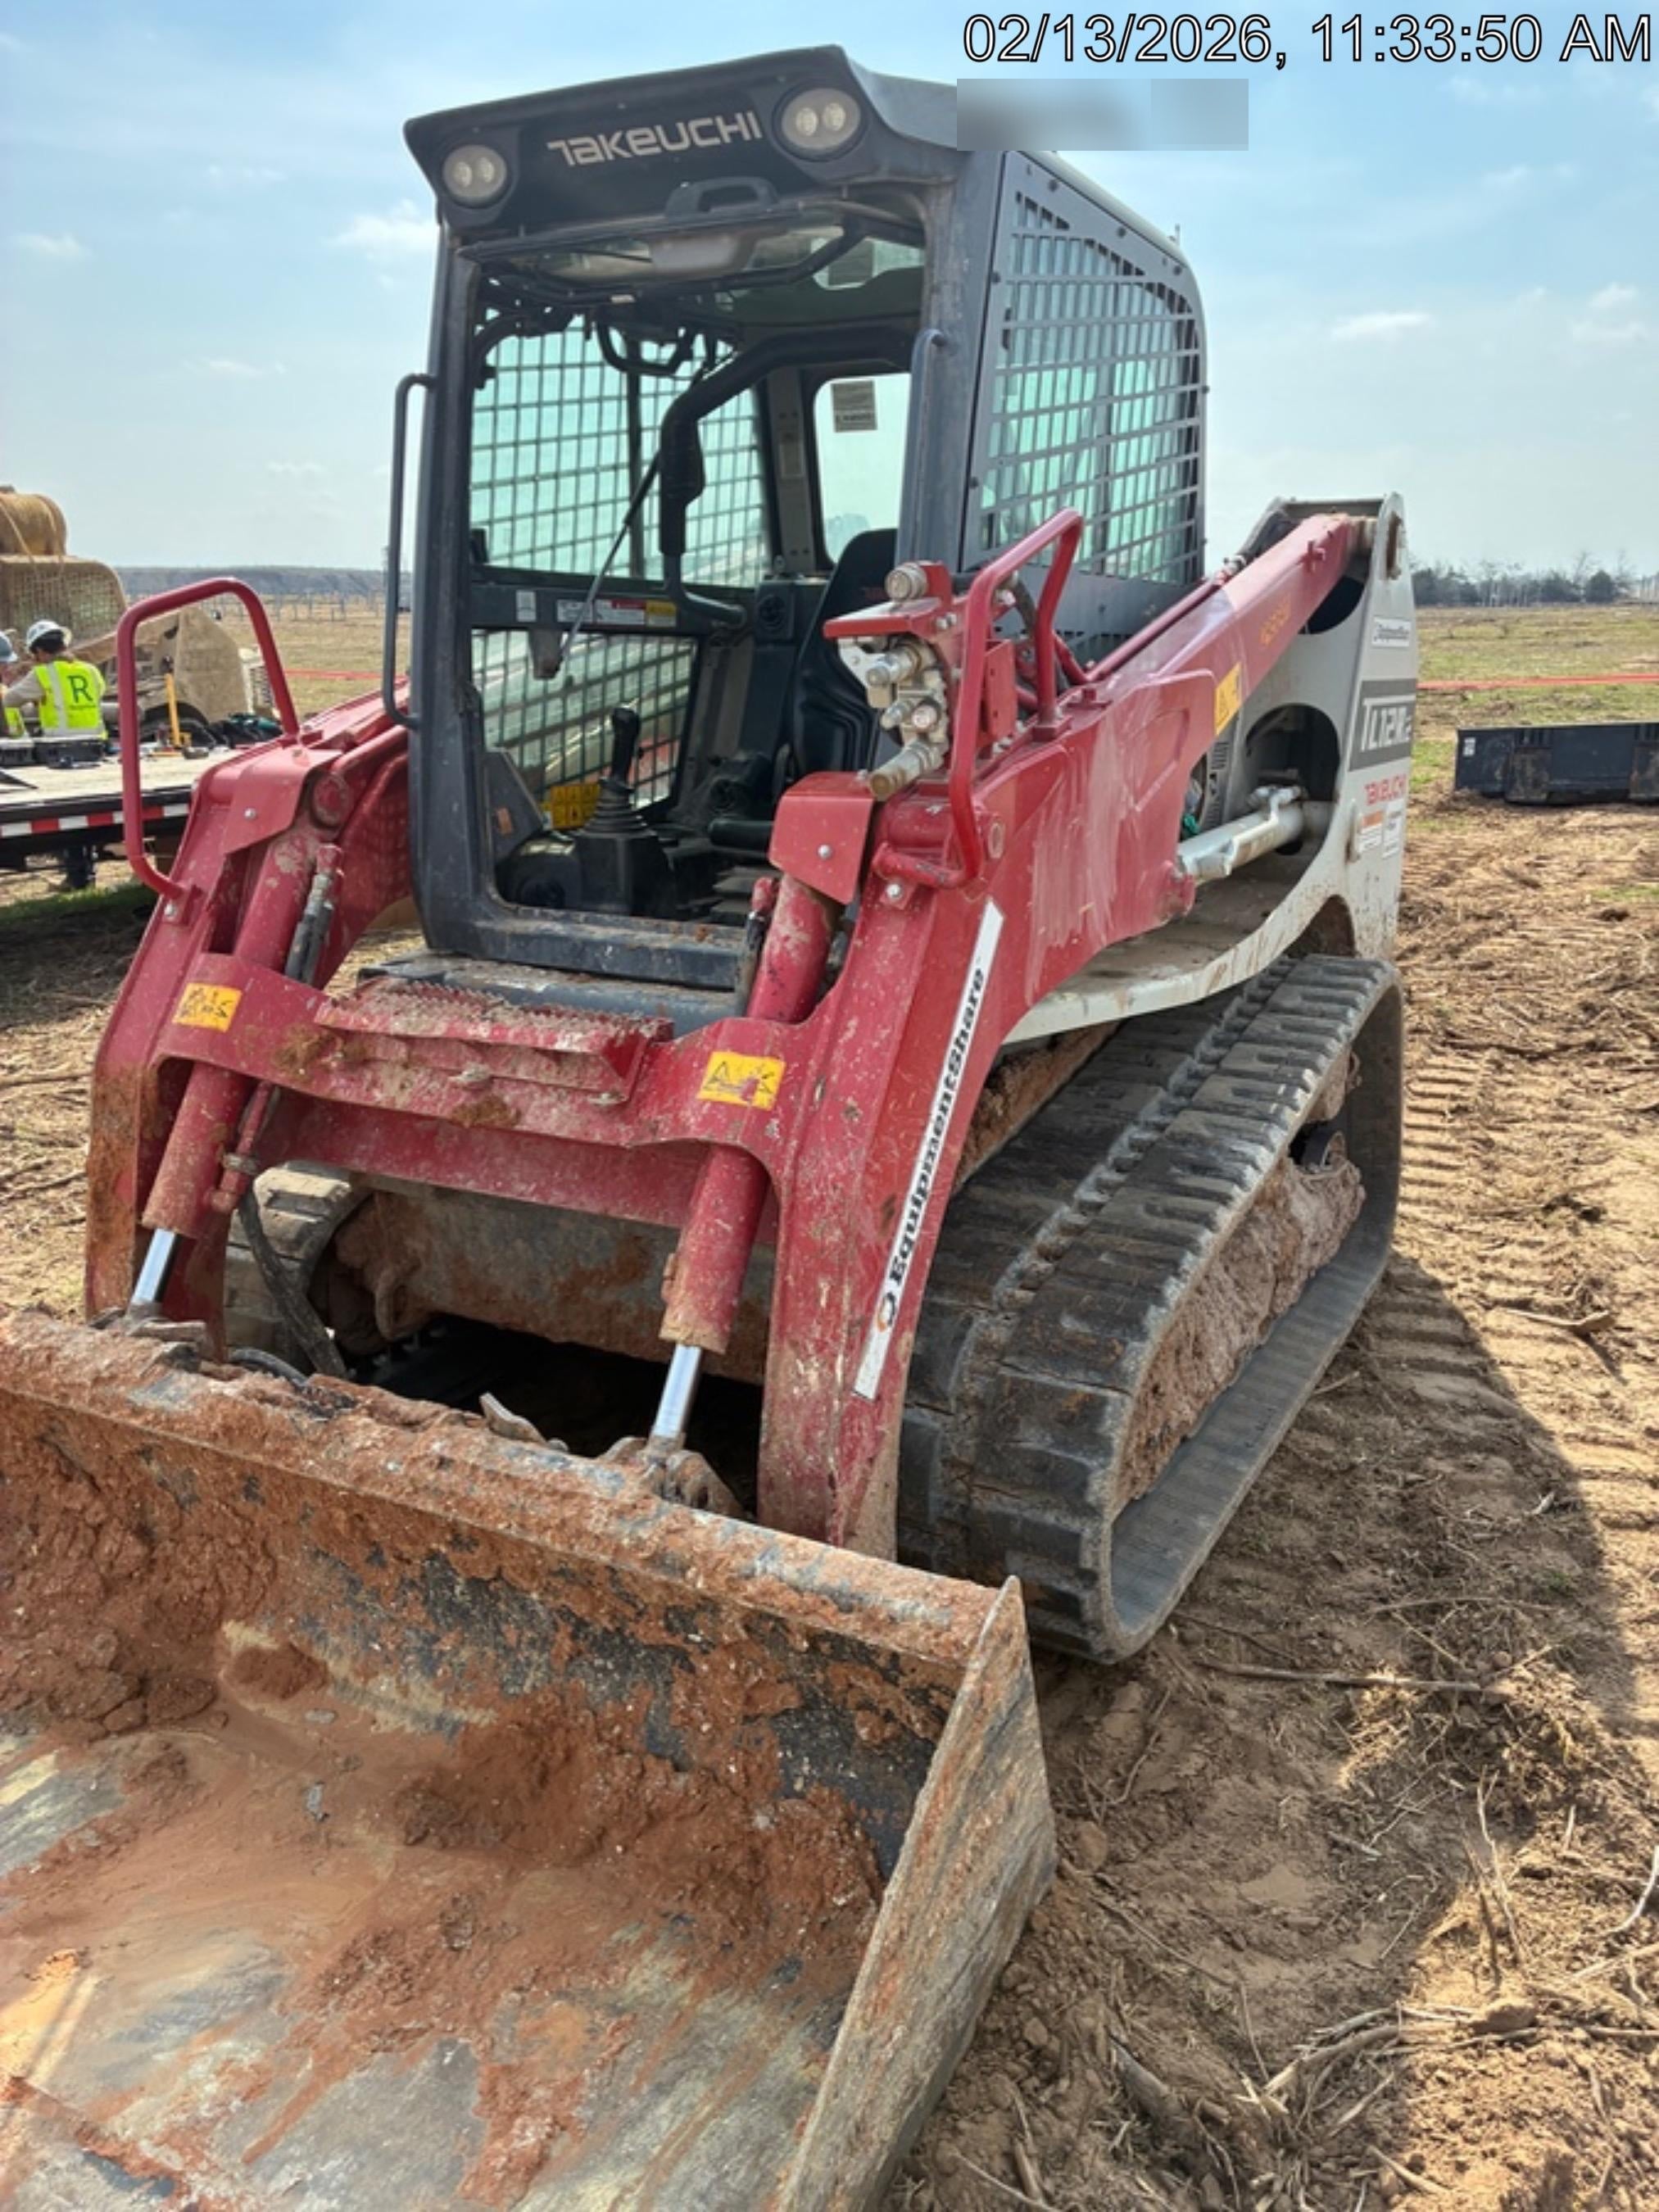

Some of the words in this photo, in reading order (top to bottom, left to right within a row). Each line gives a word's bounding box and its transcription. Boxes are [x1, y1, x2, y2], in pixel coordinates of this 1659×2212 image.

[546, 111, 762, 166] TAKEUCHI
[66, 674, 94, 704] R
[889, 968, 985, 1287] EquipmentShare
